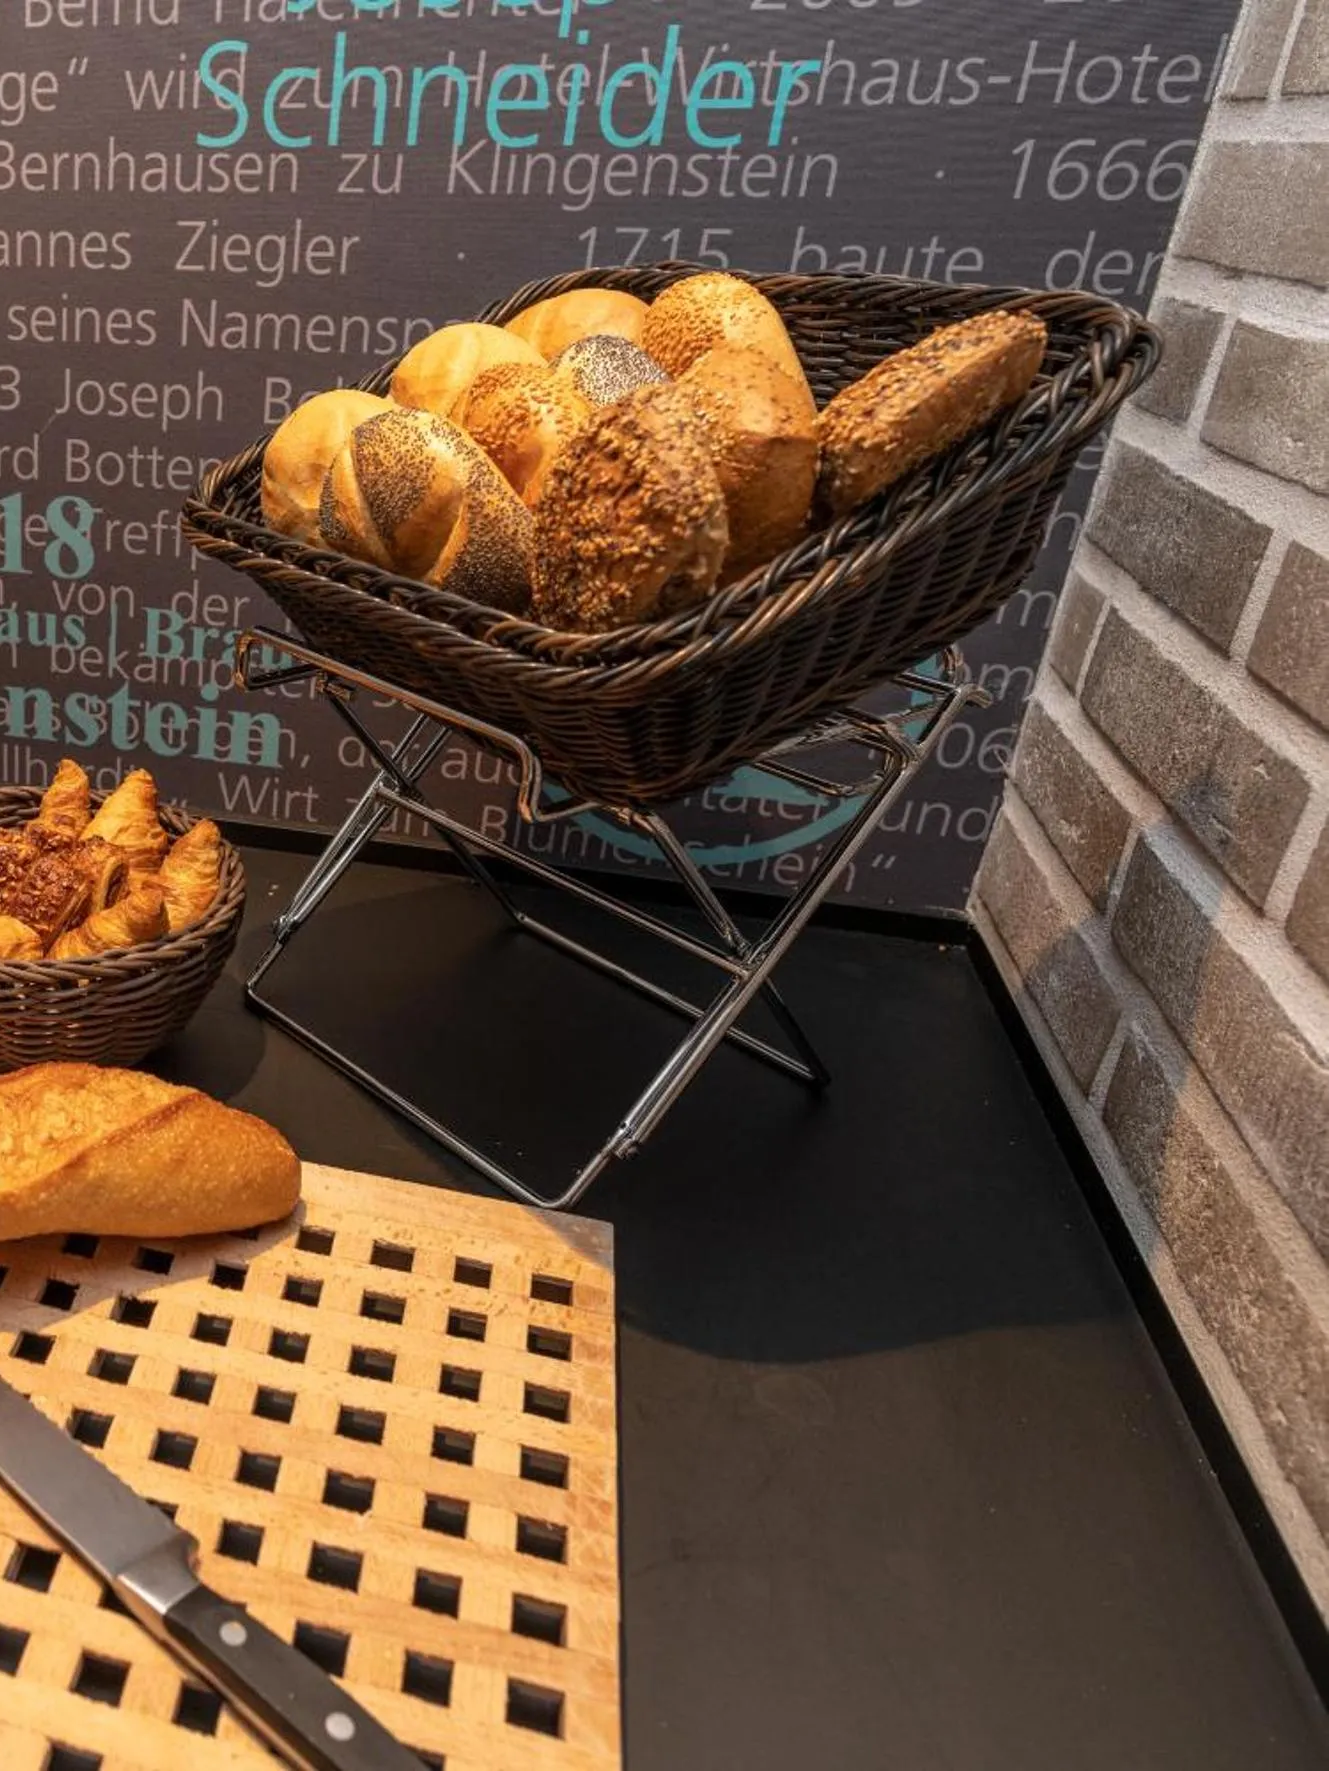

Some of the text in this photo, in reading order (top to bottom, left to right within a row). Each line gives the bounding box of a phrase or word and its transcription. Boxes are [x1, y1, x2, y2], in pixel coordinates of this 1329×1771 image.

[196, 25, 822, 148] Schneider
[338, 153, 403, 194] zu
[446, 137, 839, 211] Klingenstein
[1011, 138, 1197, 201] 1666
[175, 219, 360, 288] Ziegler
[1045, 230, 1167, 296] der
[7, 294, 157, 343] seines
[180, 297, 469, 356] Namensp
[55, 367, 224, 432] Joseph
[52, 580, 135, 619] von
[172, 579, 251, 627] der
[218, 771, 319, 823] Wirt
